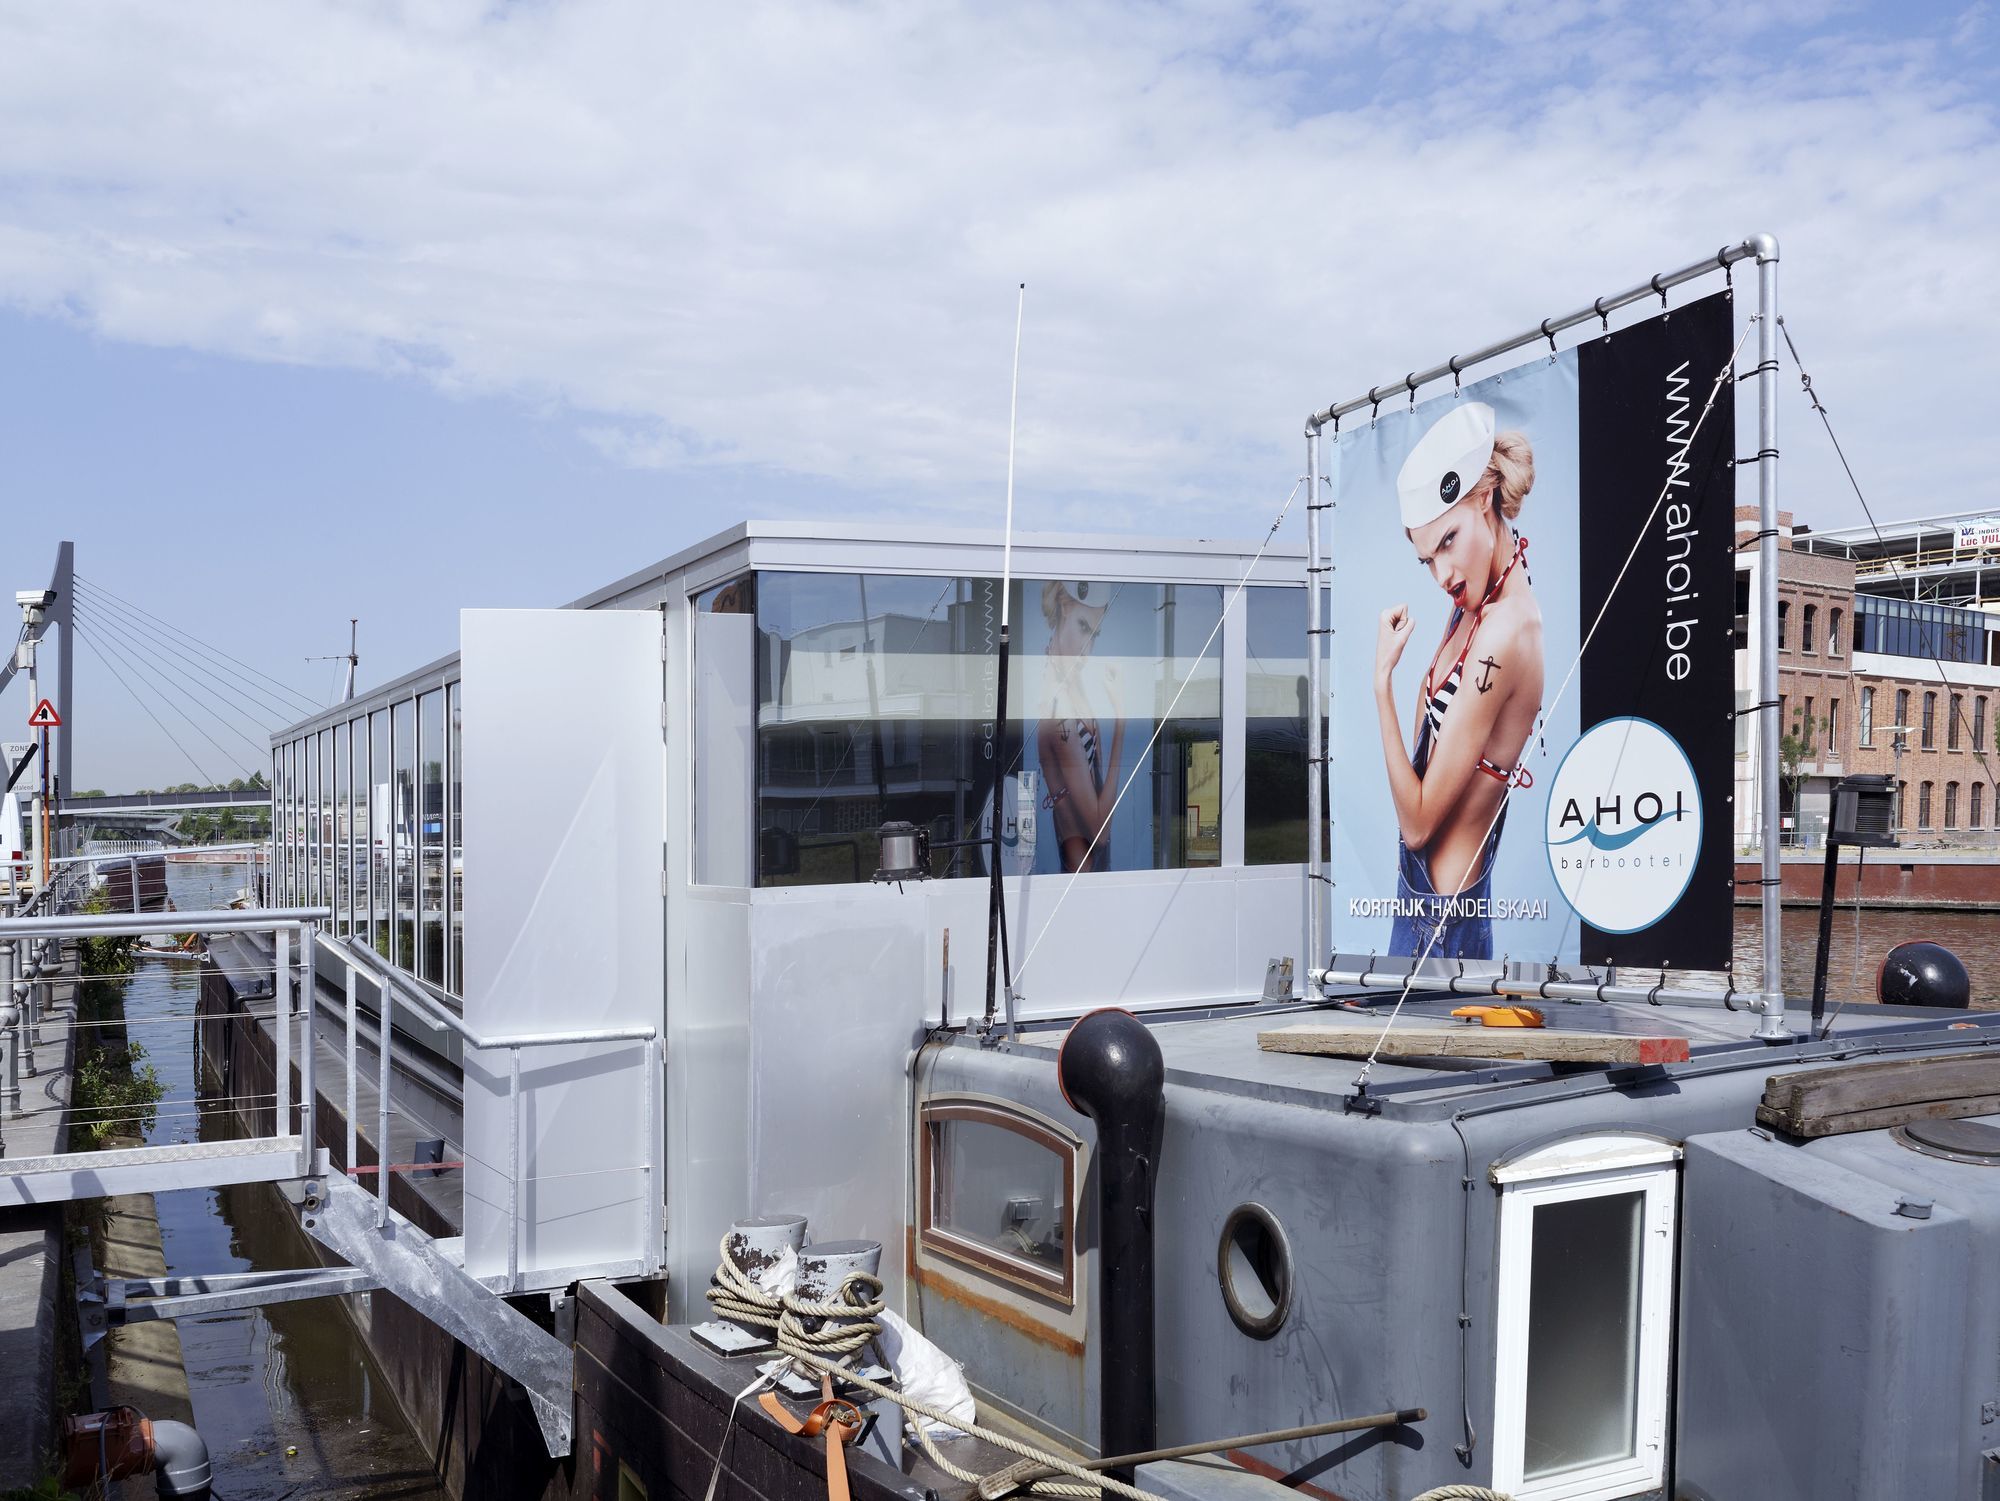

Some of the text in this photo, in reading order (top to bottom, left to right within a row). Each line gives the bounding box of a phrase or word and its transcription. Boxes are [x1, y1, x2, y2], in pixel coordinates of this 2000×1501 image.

[1442, 477, 1459, 494] AHOI
[1666, 360, 1699, 681] www.ahoi.be
[1559, 791, 1683, 828] AHOI
[1561, 853, 1683, 870] barbootel
[1349, 898, 1549, 920] KORTRIJK HANDELSKAAI
